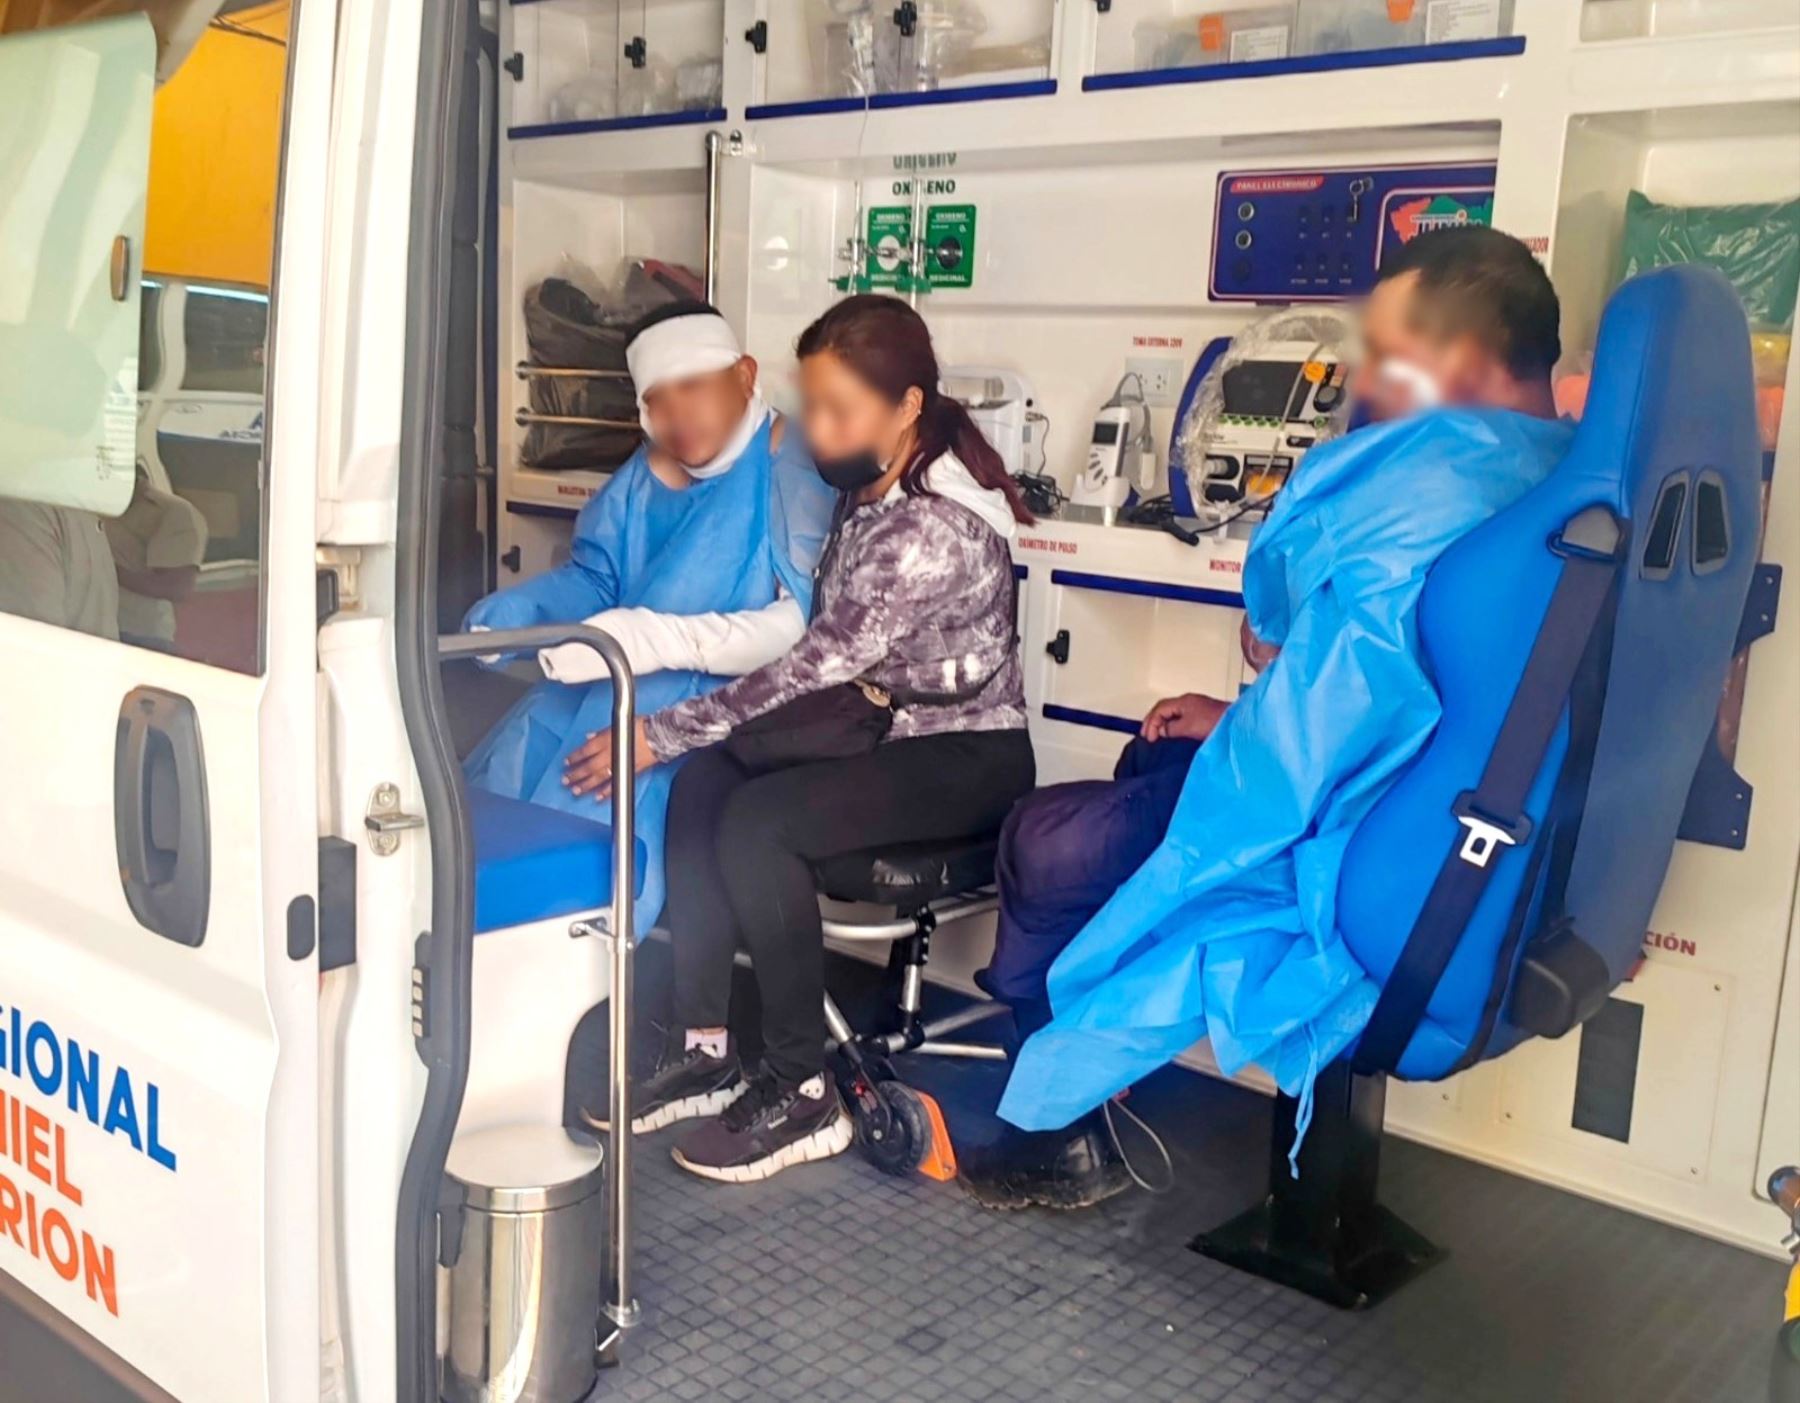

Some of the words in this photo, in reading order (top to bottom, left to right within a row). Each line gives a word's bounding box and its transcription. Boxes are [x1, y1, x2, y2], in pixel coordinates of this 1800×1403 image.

[892, 180, 956, 196] OXENO
[1058, 541, 1078, 555] PULSO
[1209, 559, 1242, 574] MONITOR
[0, 1003, 177, 1173] IONAL
[0, 1088, 83, 1208] IEL
